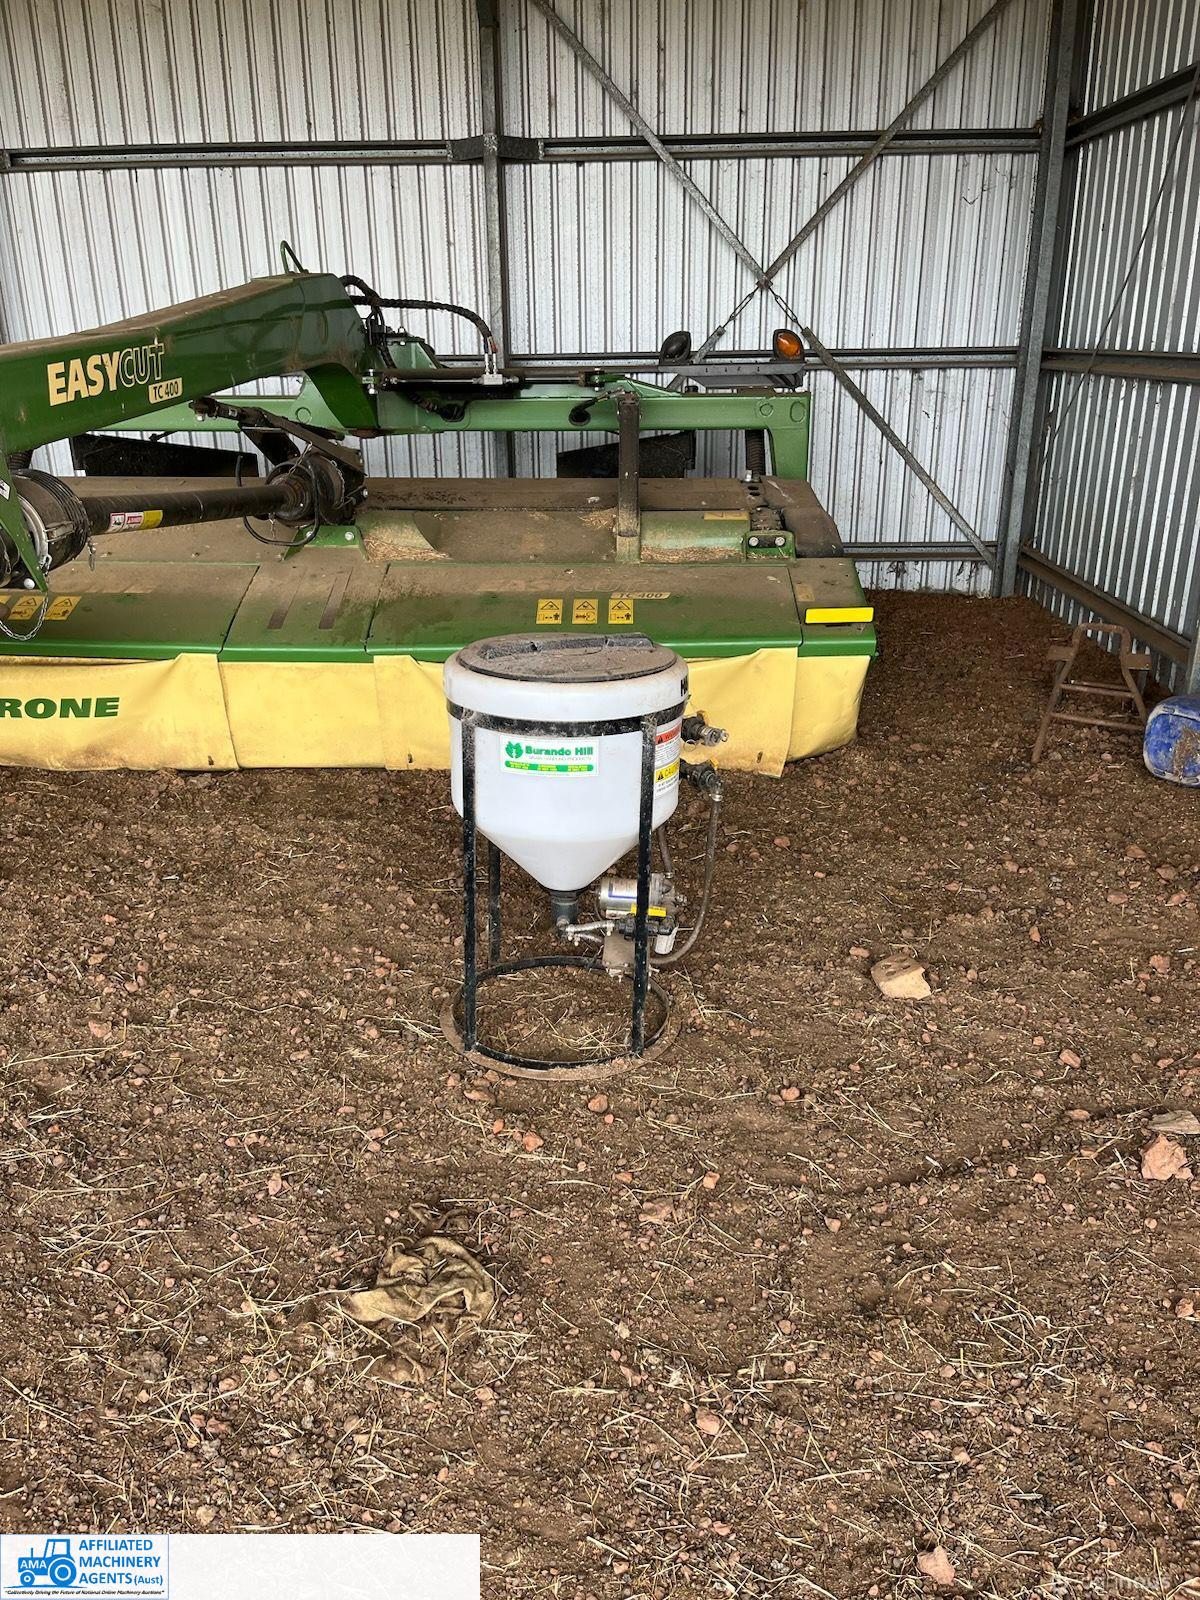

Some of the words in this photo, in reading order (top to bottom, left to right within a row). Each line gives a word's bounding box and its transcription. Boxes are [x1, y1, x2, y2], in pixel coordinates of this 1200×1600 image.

[47, 342, 164, 407] EASYCUT
[153, 385, 164, 399] TC
[164, 382, 179, 398] 400
[525, 745, 572, 756] Burando
[574, 746, 594, 756] Hill
